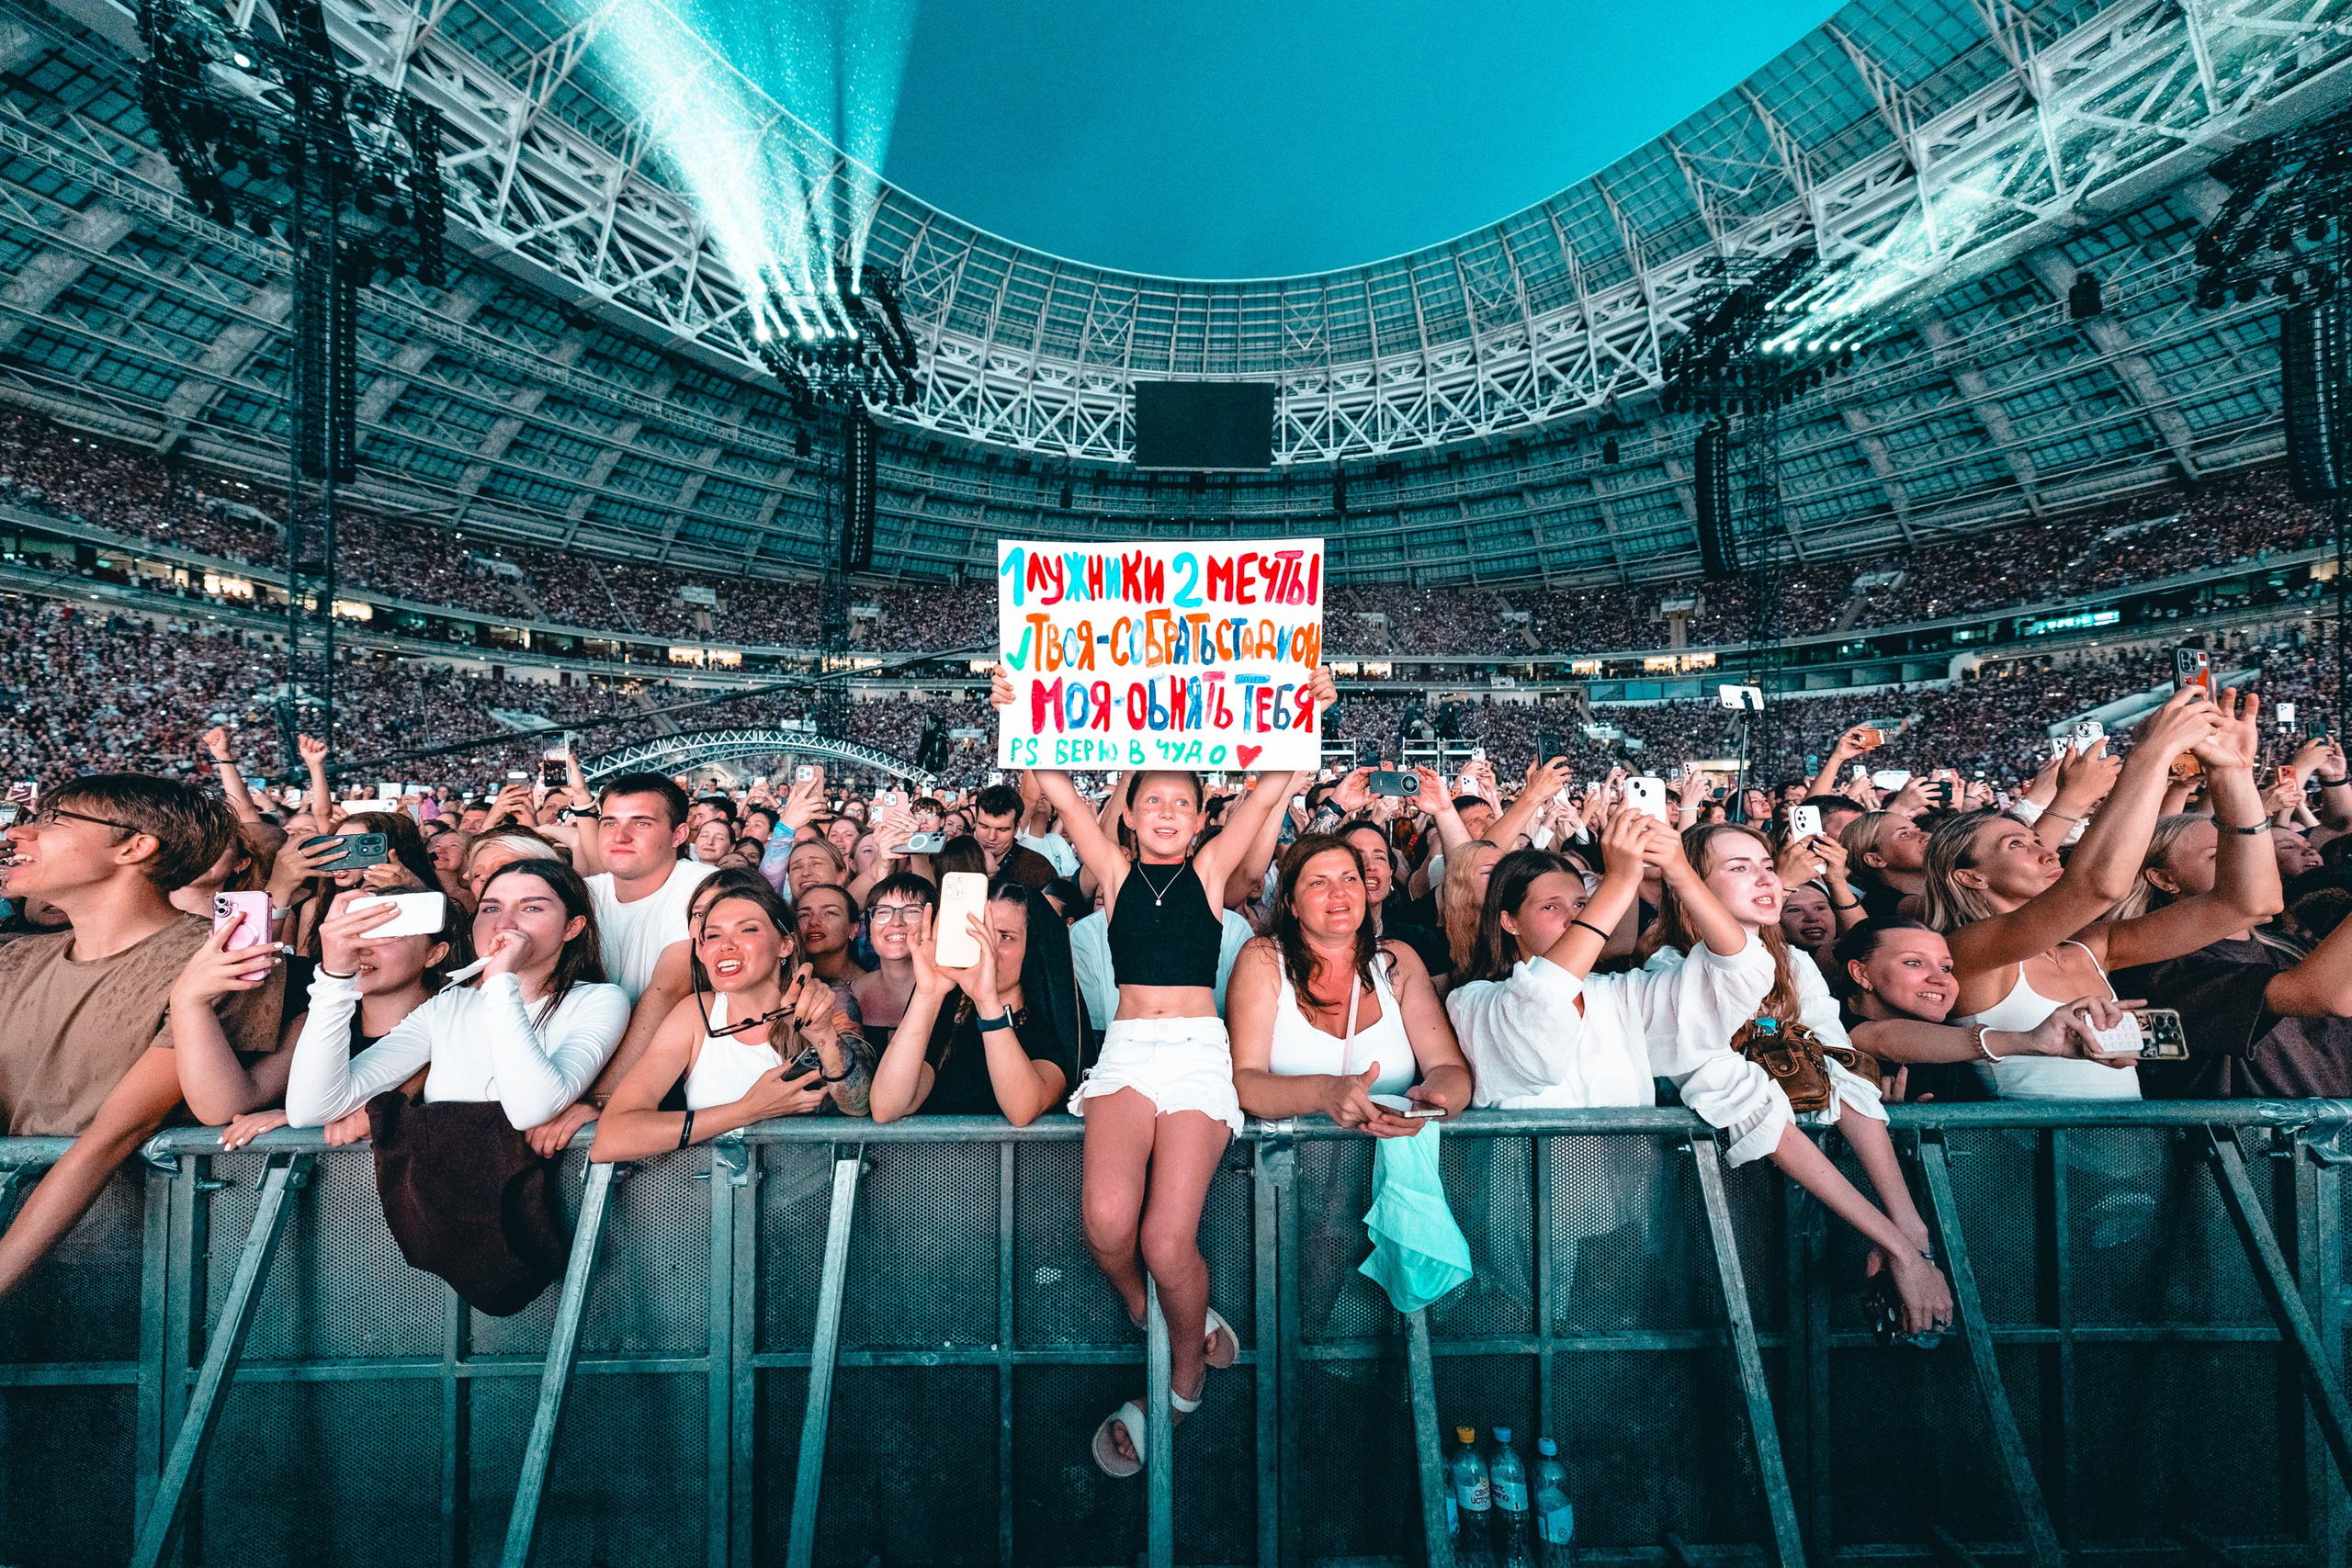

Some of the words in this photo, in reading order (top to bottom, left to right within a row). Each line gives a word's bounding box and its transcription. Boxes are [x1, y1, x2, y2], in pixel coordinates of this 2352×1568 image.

[1001, 547, 1024, 606] 1
[1026, 549, 1164, 605] ЛУЖНИКИ
[1172, 552, 1203, 608] 2
[1207, 550, 1320, 606] МЕЧТЫ
[1235, 673, 1315, 735] ТЕБЯ
[1056, 739, 1118, 765] ВЕРЮ
[1129, 739, 1146, 765] В
[1156, 739, 1227, 765] ЧУДО
